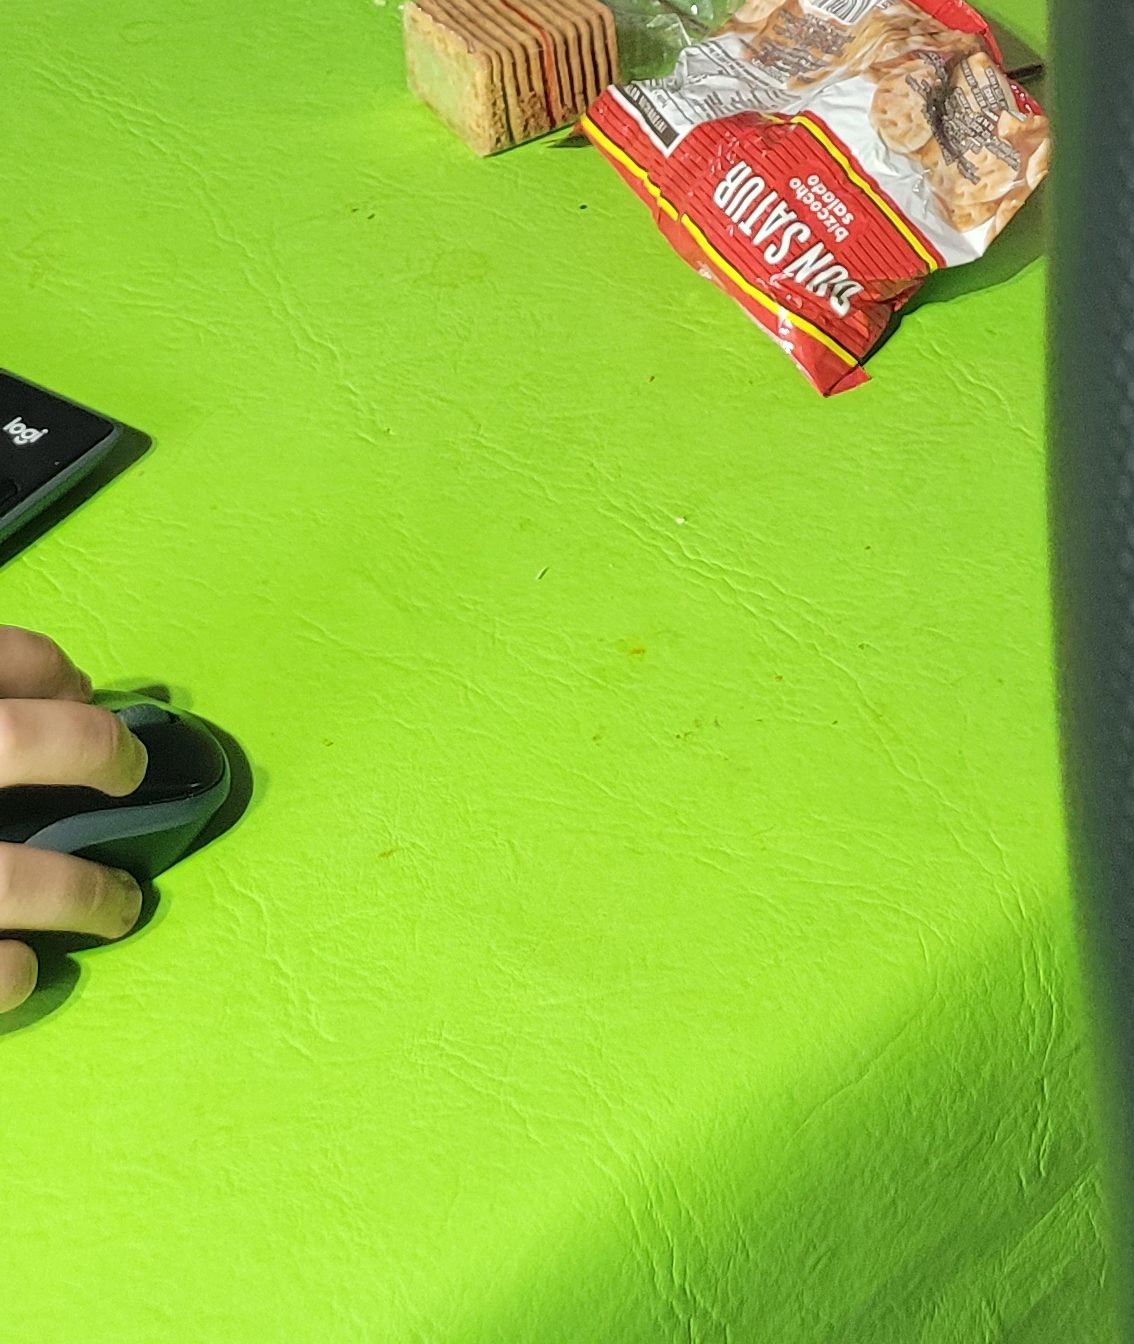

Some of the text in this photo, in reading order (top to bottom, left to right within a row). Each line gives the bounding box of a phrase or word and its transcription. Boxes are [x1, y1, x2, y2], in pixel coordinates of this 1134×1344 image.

[712, 160, 812, 266] SATUR
[788, 177, 850, 243] bizcocho
[806, 174, 855, 225] salado
[782, 241, 865, 318] DON
[2, 416, 49, 445] logi
